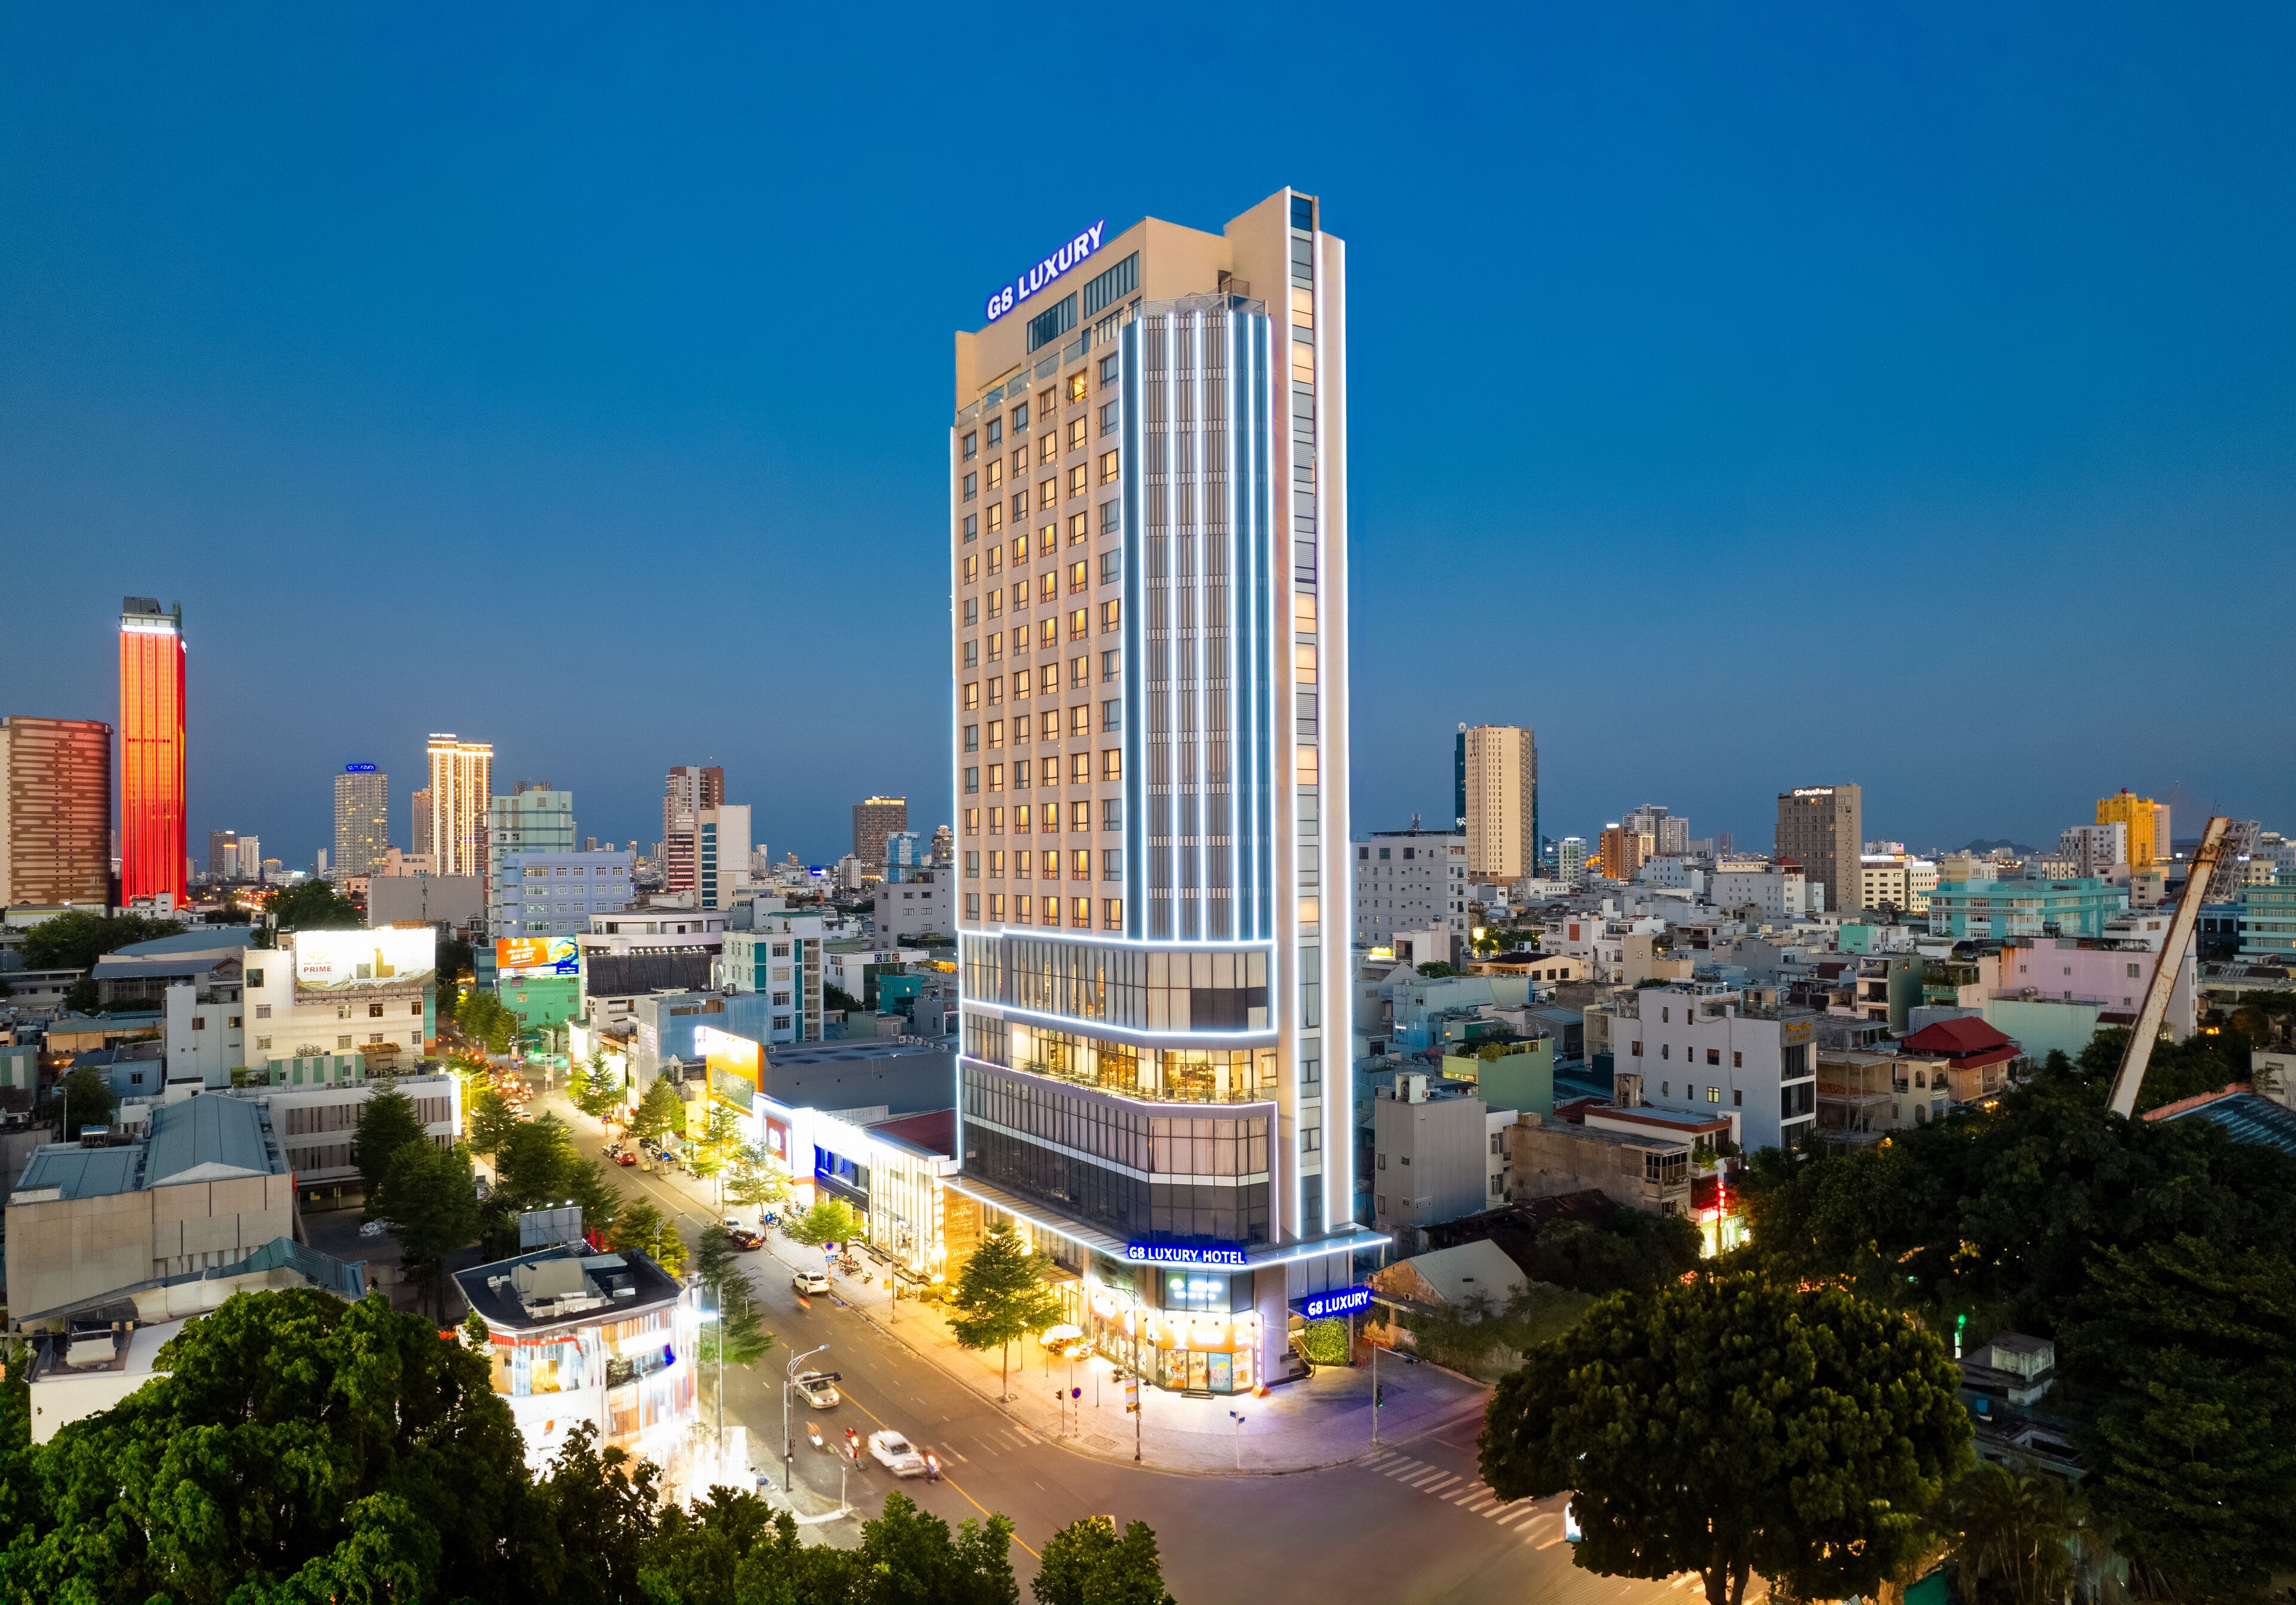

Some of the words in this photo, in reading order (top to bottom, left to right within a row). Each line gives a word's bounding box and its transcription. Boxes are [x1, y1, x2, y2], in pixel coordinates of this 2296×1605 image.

[987, 286, 1013, 320] G8
[1018, 220, 1104, 300] LUXURY
[875, 953, 900, 963] DHC
[1129, 1246, 1145, 1259] G8
[1148, 1248, 1198, 1262] LUXURY
[1203, 1250, 1245, 1264] HOTEL
[1308, 1301, 1323, 1316] G8
[1326, 1291, 1369, 1313] LUXURY
